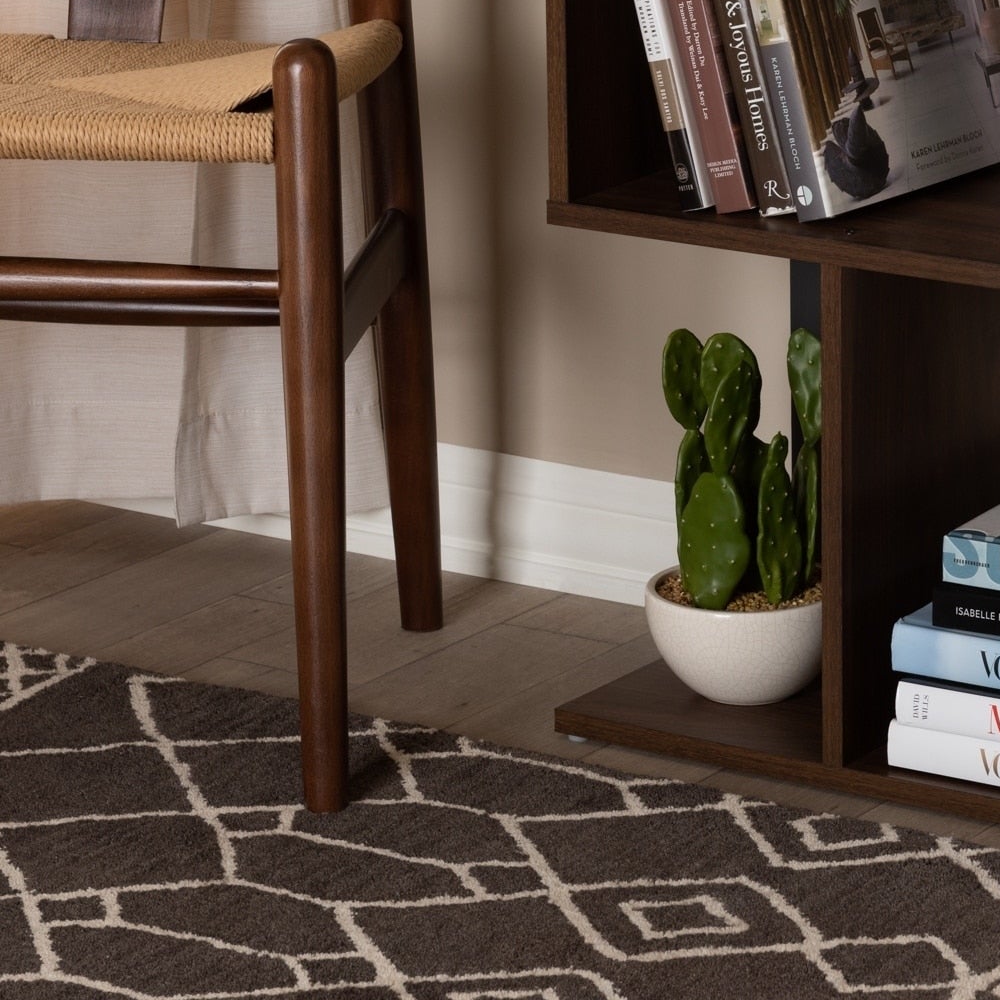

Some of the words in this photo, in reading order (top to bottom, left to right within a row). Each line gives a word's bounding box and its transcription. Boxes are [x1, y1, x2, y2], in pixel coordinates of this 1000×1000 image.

[725, 1, 743, 18] &
[728, 21, 753, 83] Joyous
[745, 85, 769, 151] Homes
[770, 57, 783, 90] KAREN
[778, 90, 793, 135] LEHRMAN
[789, 137, 801, 170] BLOCH
[763, 180, 791, 199] R
[955, 606, 996, 621] ISABELLE
[912, 693, 920, 719] DAVID
